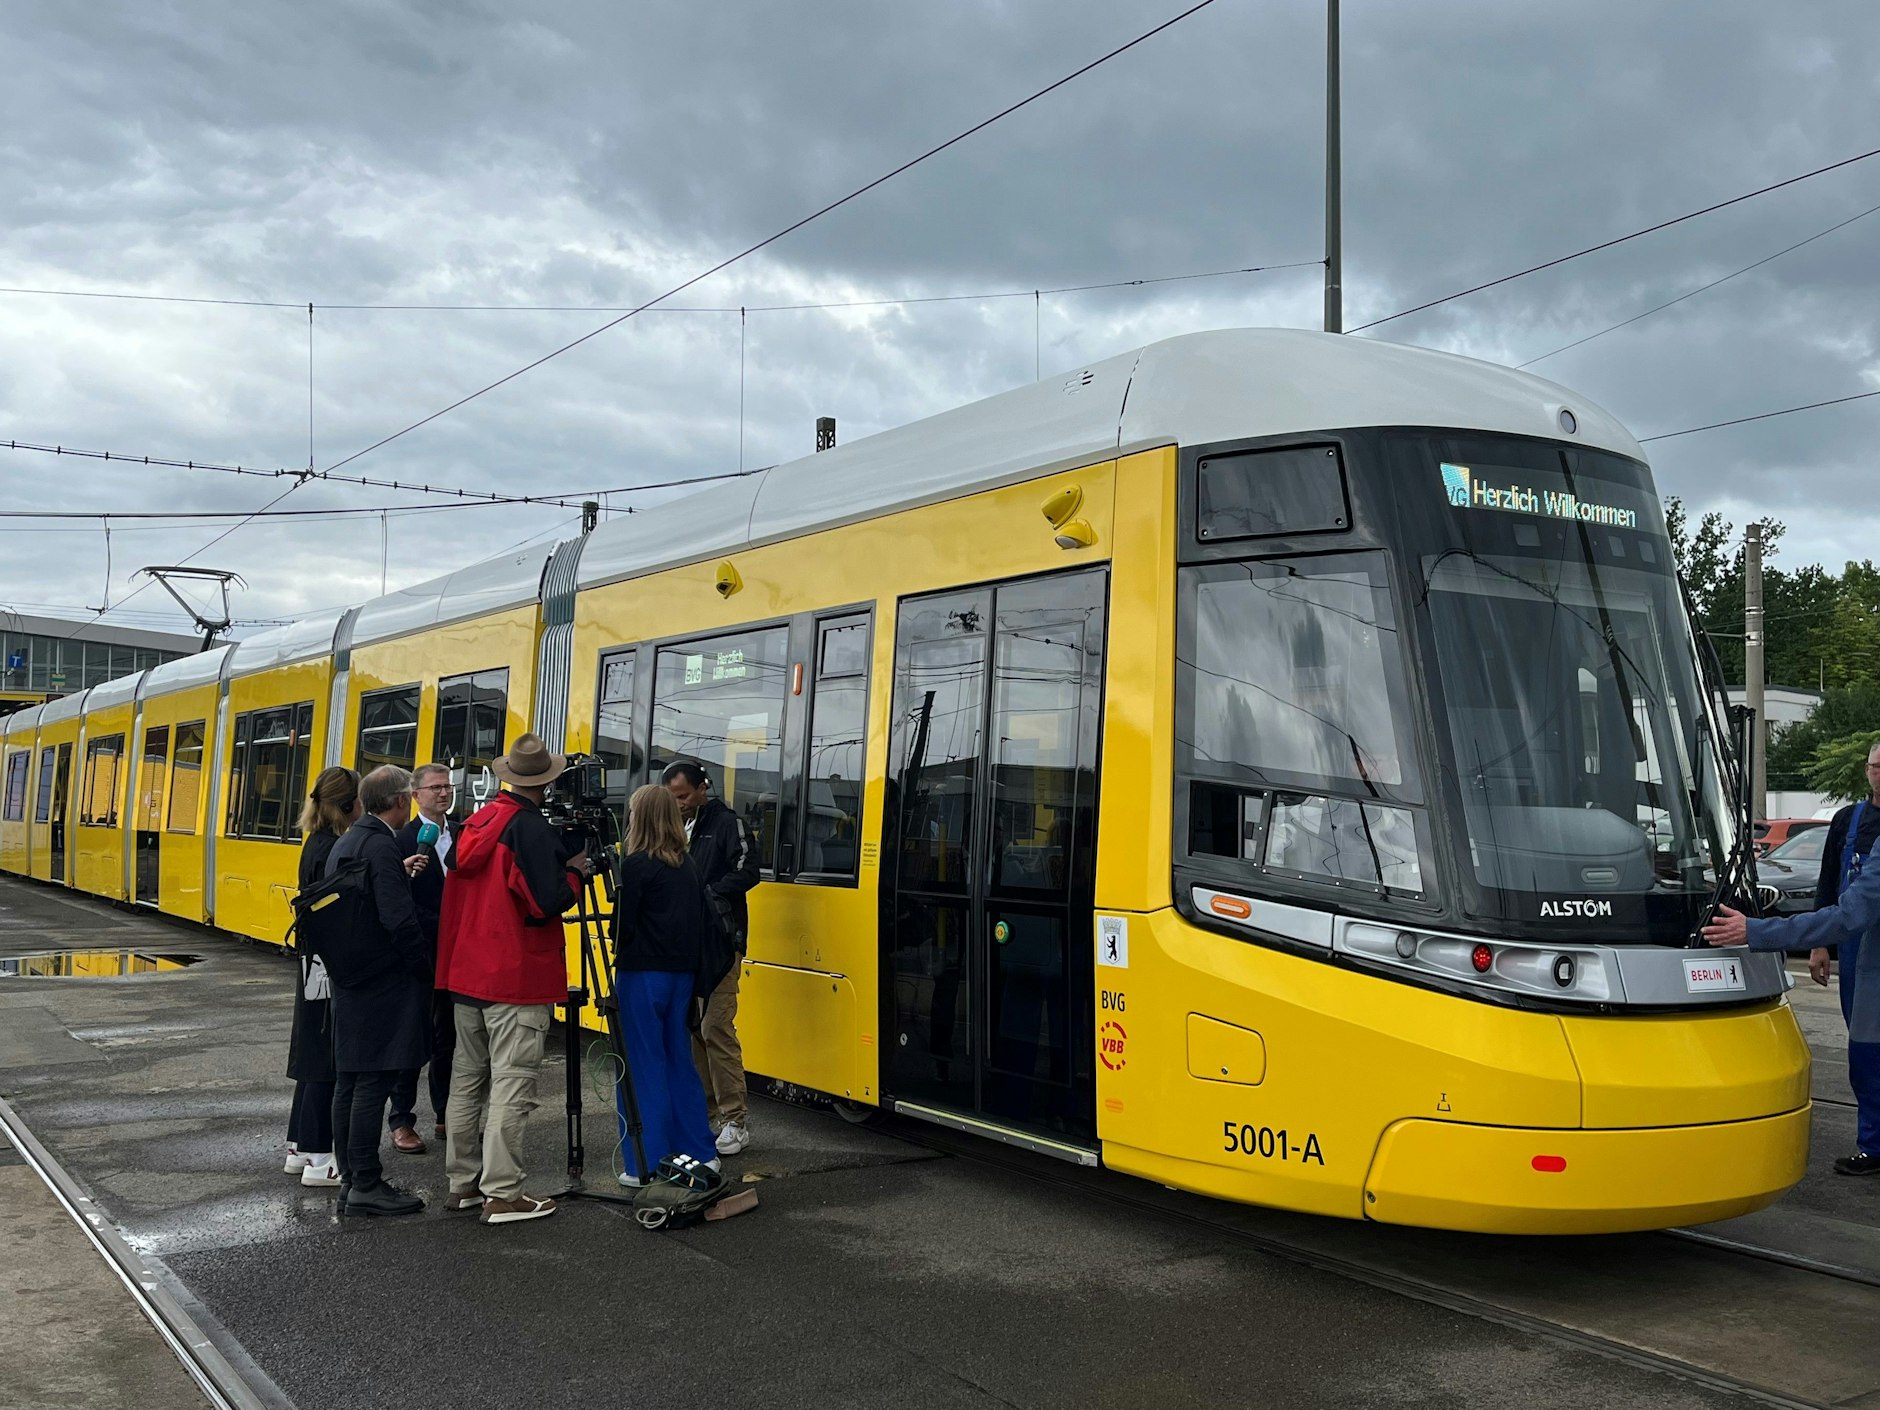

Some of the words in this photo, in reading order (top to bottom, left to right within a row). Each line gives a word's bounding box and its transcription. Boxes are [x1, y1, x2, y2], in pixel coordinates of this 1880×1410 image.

[1473, 478, 1539, 513] Herzlich
[1543, 490, 1636, 528] Willkommen
[1540, 899, 1612, 917] ALSTOM
[1691, 969, 1722, 982] BERLIN
[1101, 990, 1126, 1012] BVG
[1101, 1037, 1124, 1054] VBB
[1223, 1121, 1325, 1166] 5001-A
